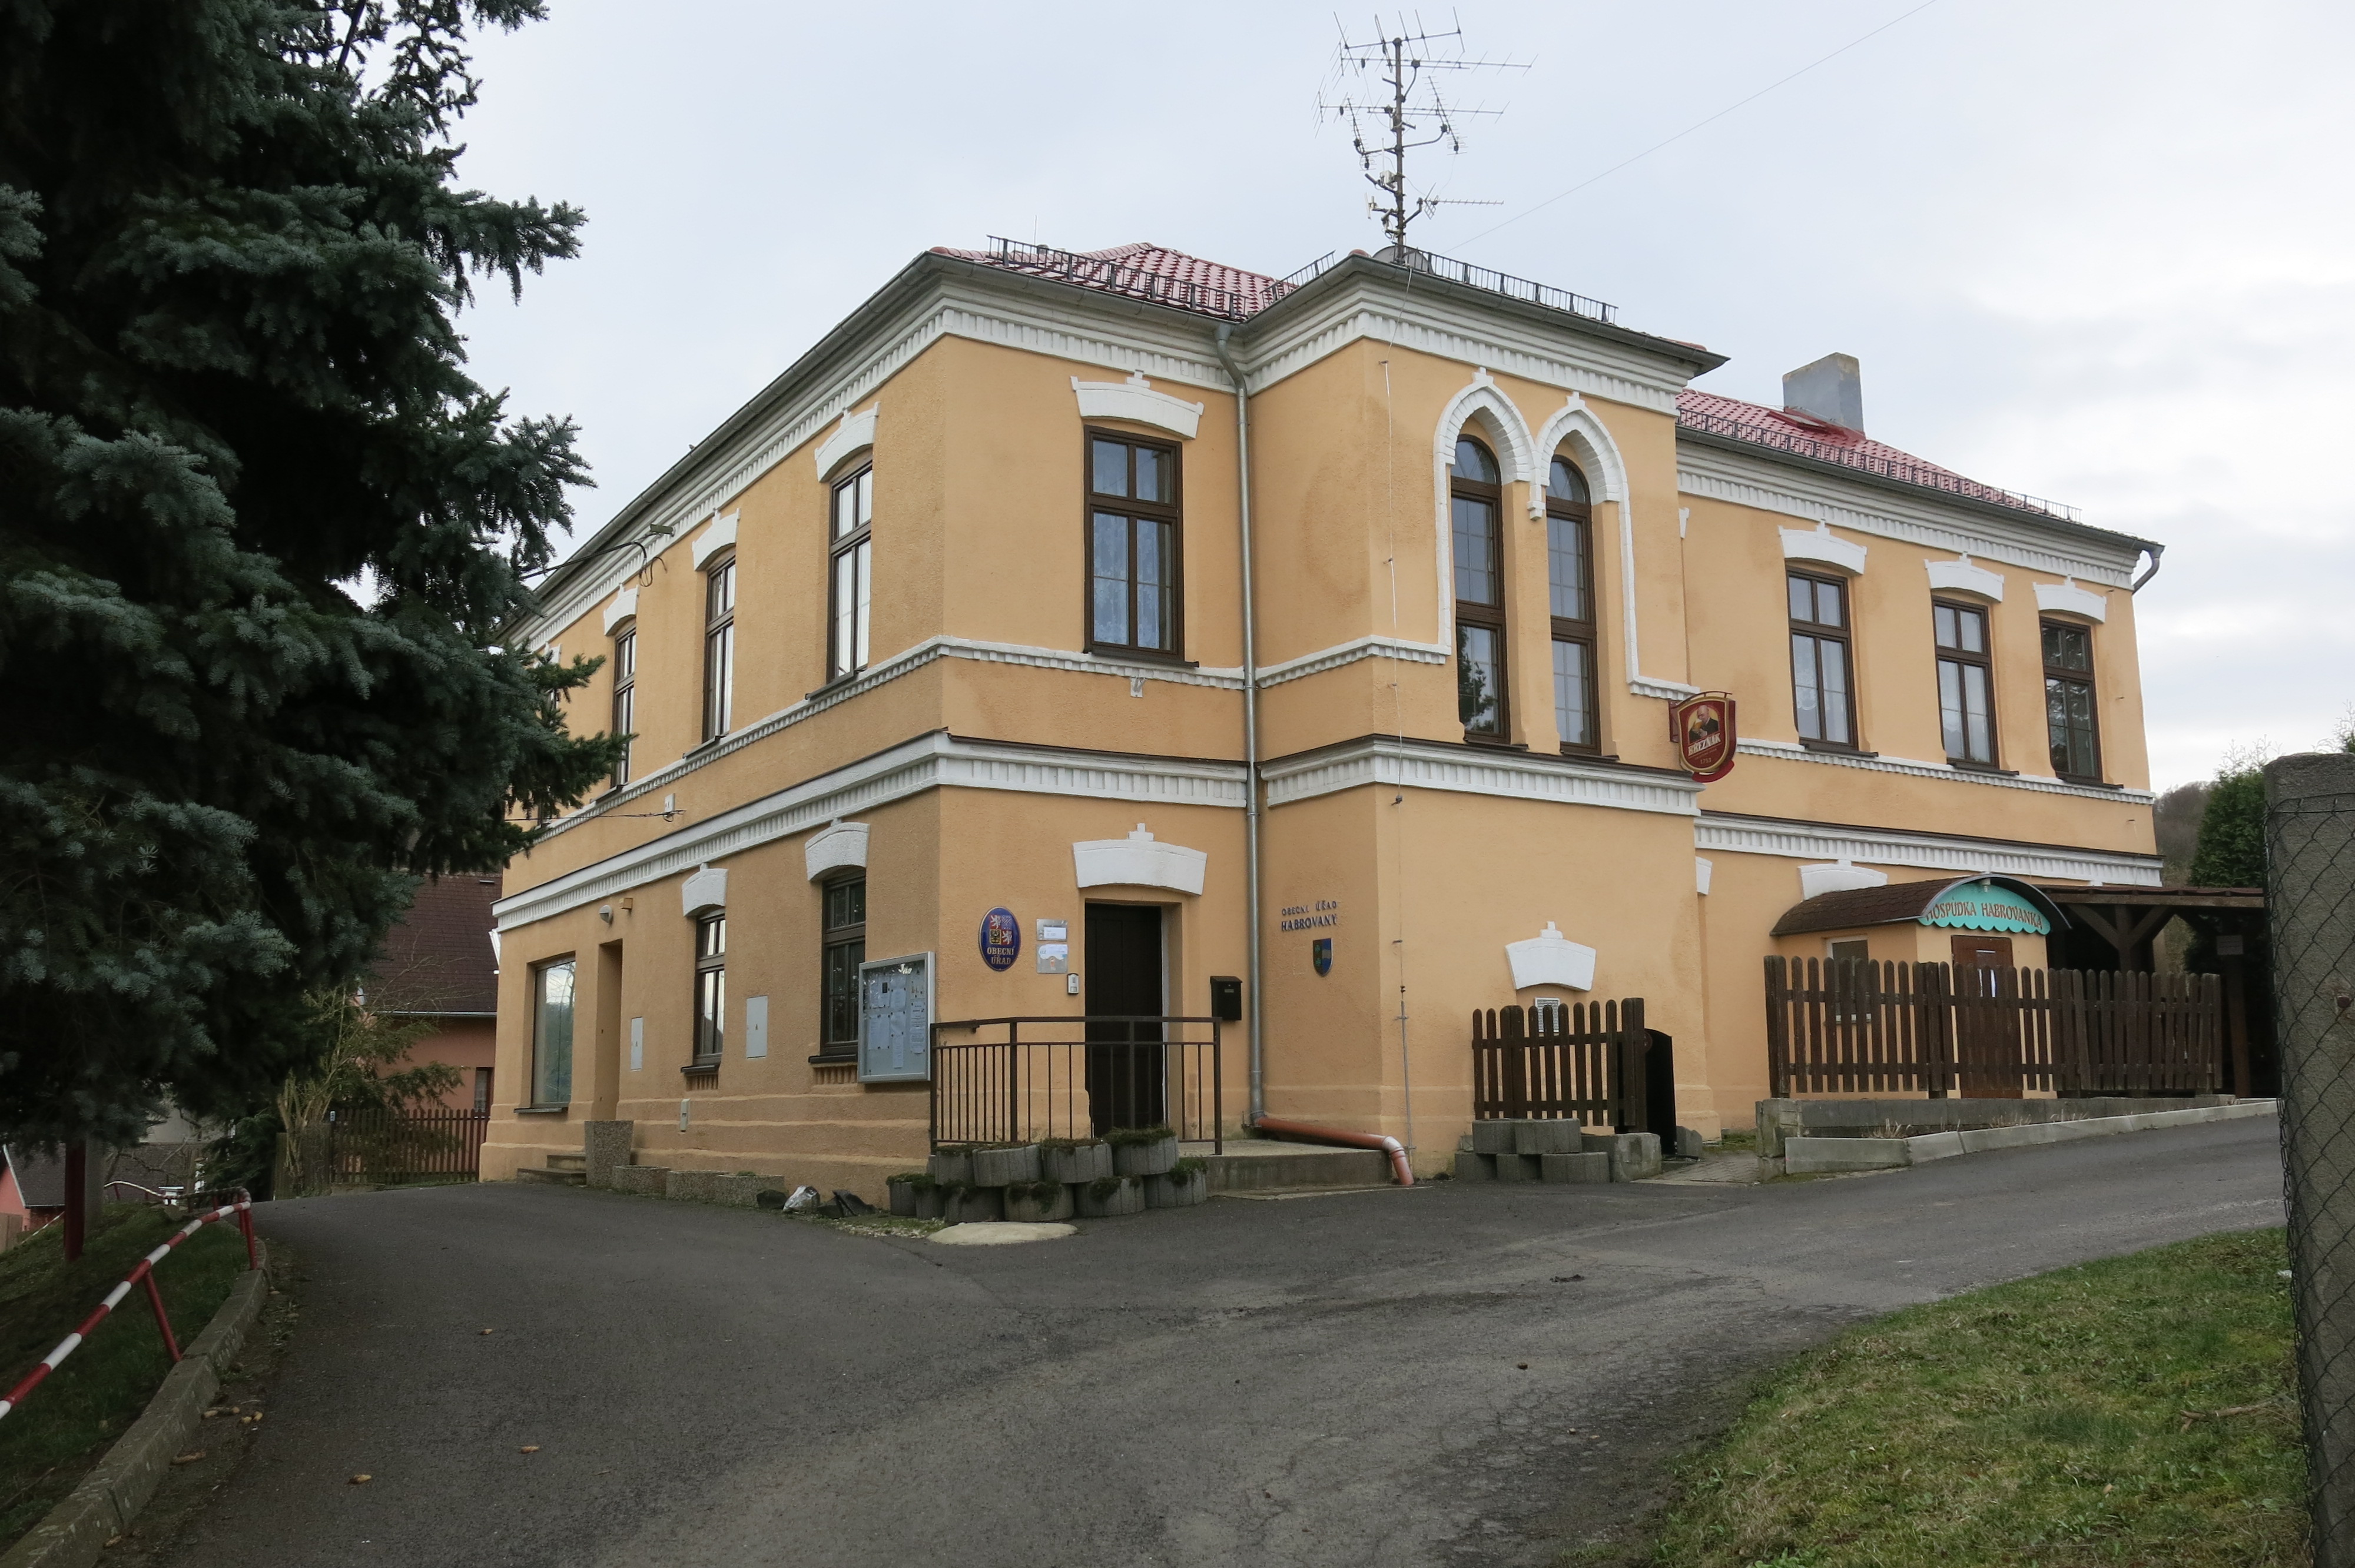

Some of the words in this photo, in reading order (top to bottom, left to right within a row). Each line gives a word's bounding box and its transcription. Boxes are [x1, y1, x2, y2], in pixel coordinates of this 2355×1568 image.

[1281, 913, 1337, 931] HABROVANY
[1981, 902, 2043, 930] HABROVANKA
[987, 946, 1014, 956] OBECNÍ
[991, 955, 1011, 965] ÚŘAD
